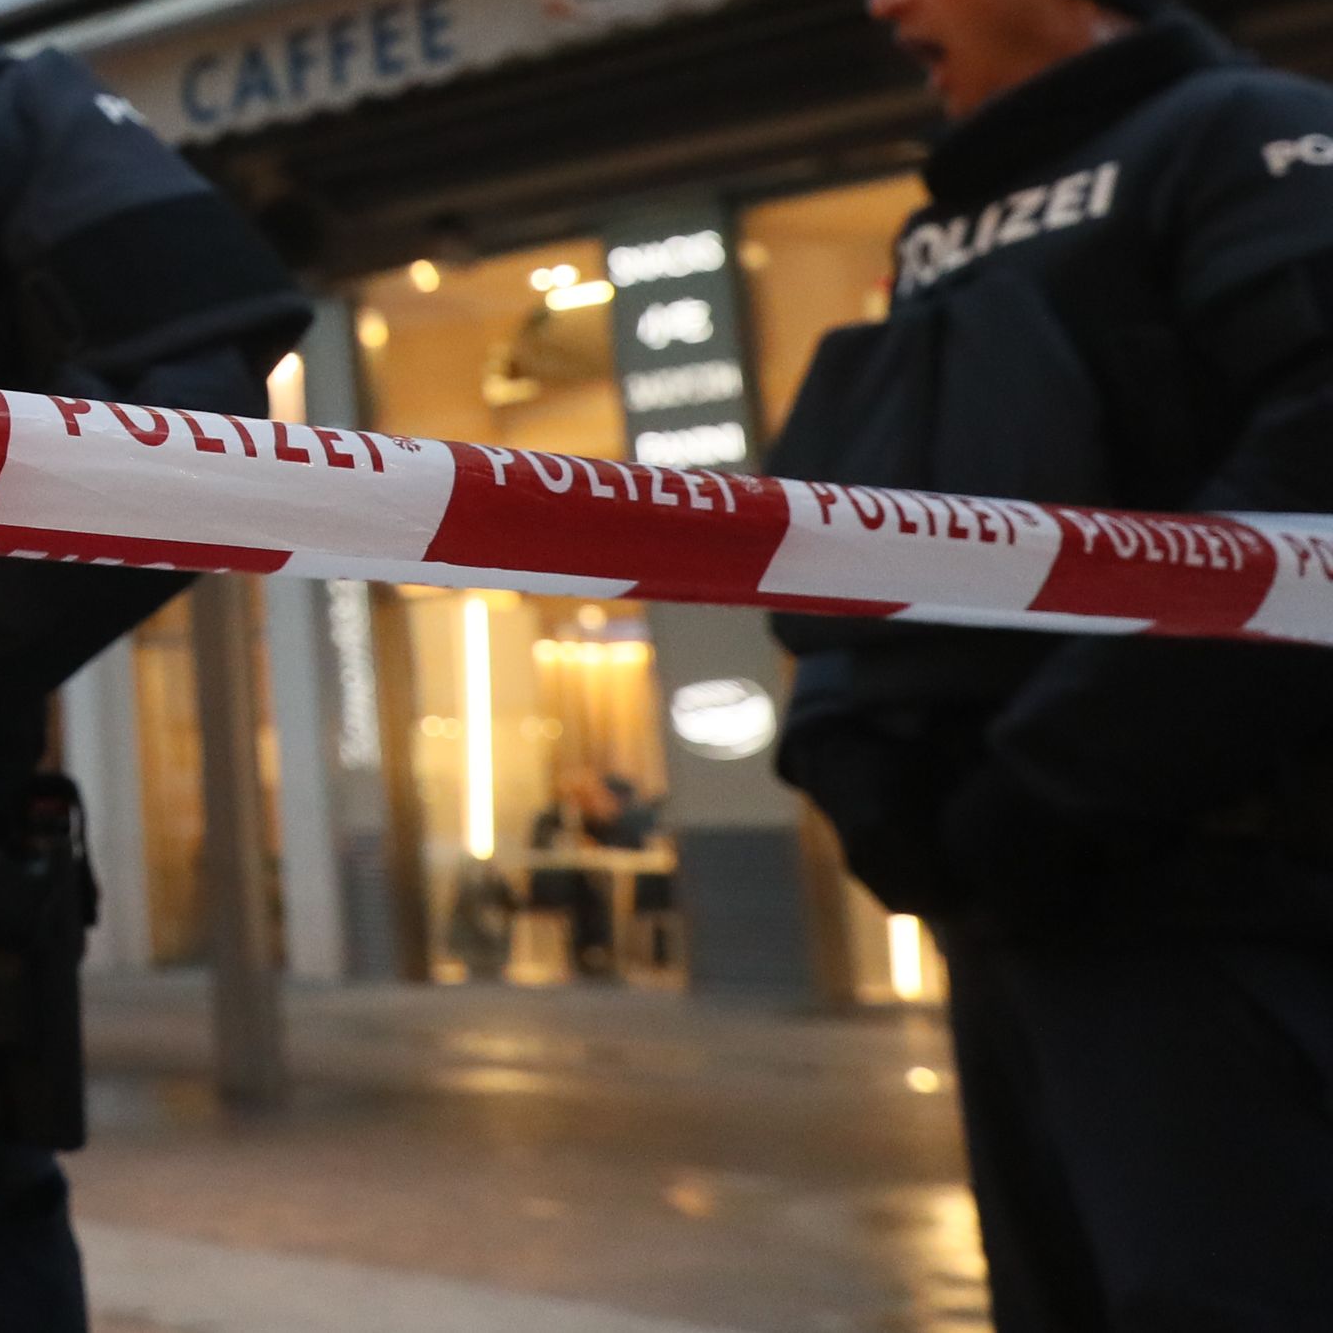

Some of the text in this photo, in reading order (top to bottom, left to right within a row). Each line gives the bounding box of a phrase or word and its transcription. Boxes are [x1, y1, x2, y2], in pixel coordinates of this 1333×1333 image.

[48, 395, 385, 473] POLIZEI
[470, 443, 736, 513] POLIZEI
[806, 481, 1016, 545] POLIZEI
[1057, 507, 1243, 571] POLIZEI
